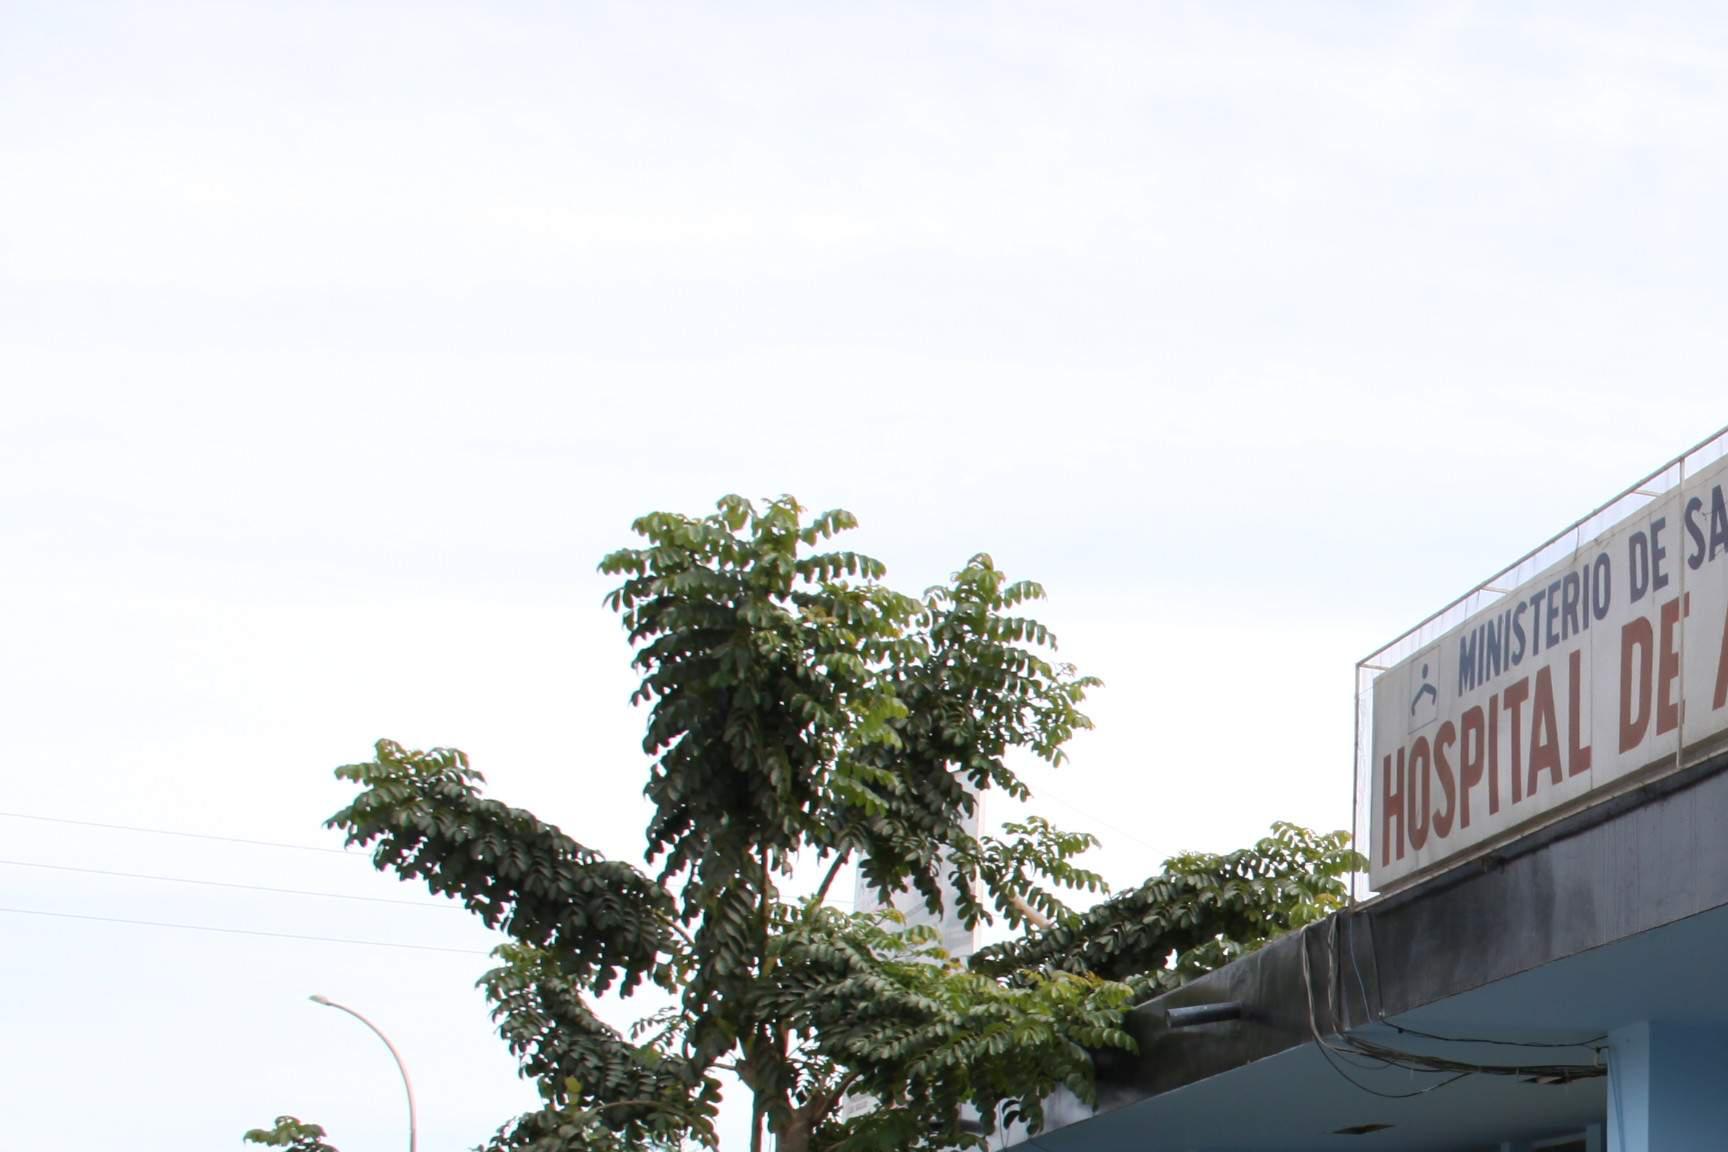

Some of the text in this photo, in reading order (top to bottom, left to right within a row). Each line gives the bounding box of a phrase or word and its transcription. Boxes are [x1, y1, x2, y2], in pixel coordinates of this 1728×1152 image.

[1458, 551, 1612, 697] MINISTERIO
[1628, 526, 1669, 593] DE
[1383, 661, 1591, 866] HOSPITAL
[1618, 592, 1687, 754] DE
